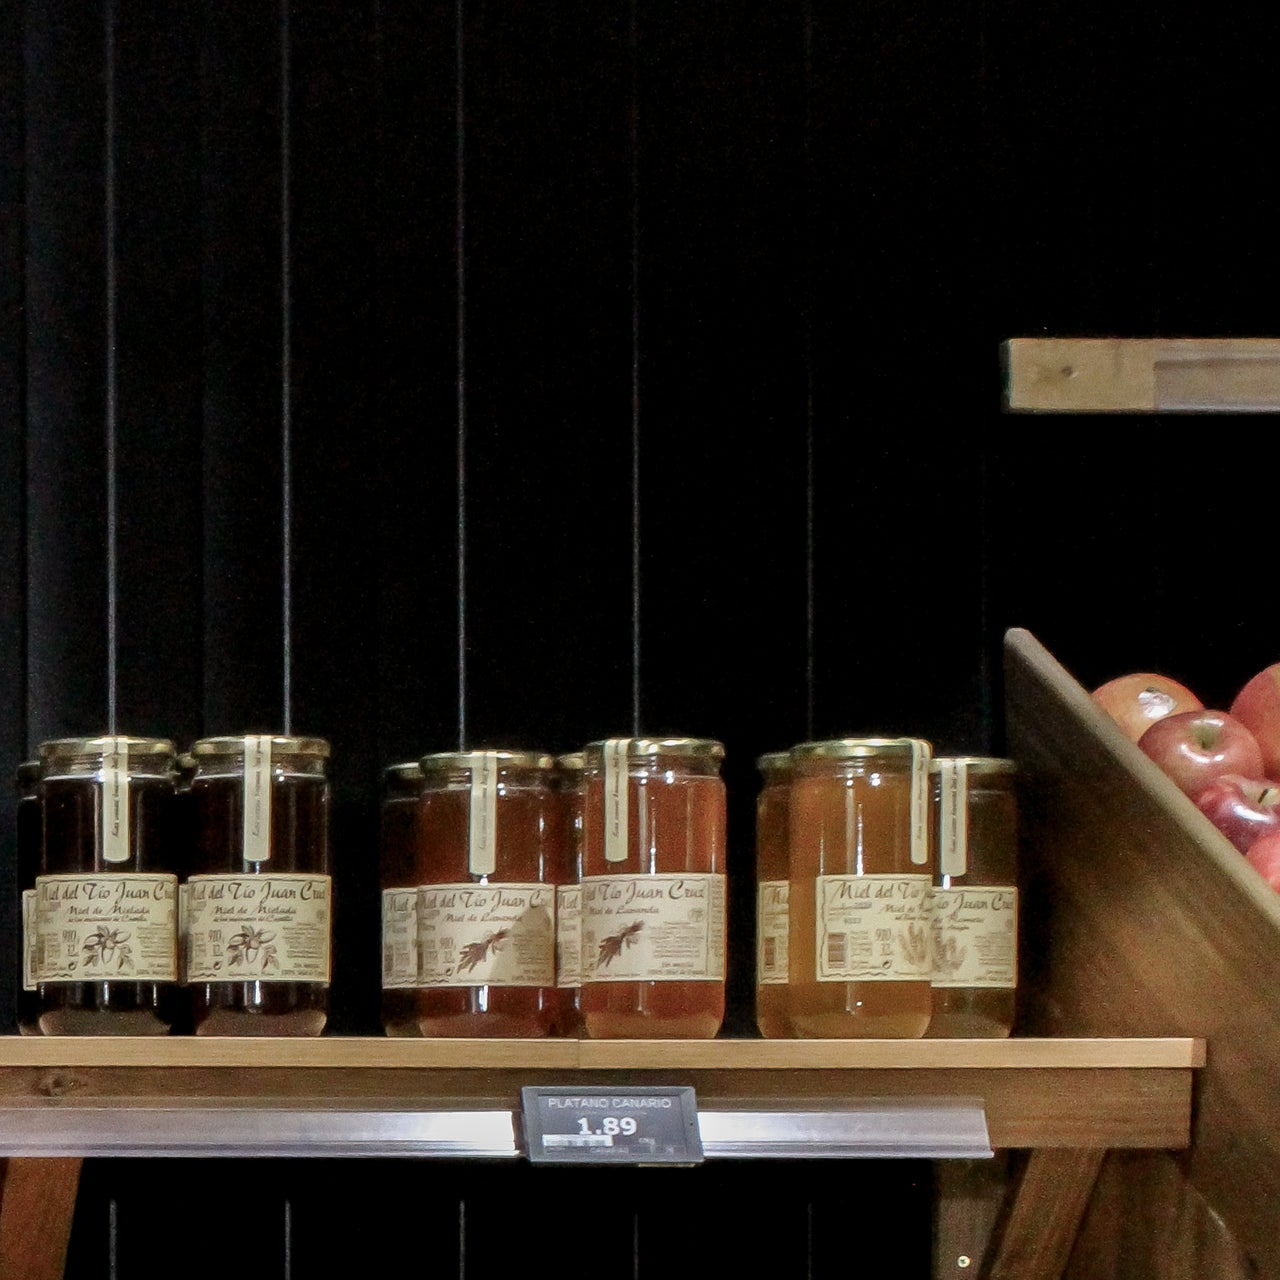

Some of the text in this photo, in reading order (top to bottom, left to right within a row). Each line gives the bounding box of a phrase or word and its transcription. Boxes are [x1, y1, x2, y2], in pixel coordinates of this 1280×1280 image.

[61, 883, 80, 899] del
[115, 881, 150, 905] Juan
[260, 881, 297, 905] Juan
[490, 890, 525, 912] Juan
[625, 881, 663, 904] Juan
[668, 880, 705, 900] Cruz
[831, 881, 871, 900] Miel
[874, 883, 894, 899] del
[548, 1098, 672, 1109] PLATANO CANARIO
[576, 1116, 638, 1136] 1.89
